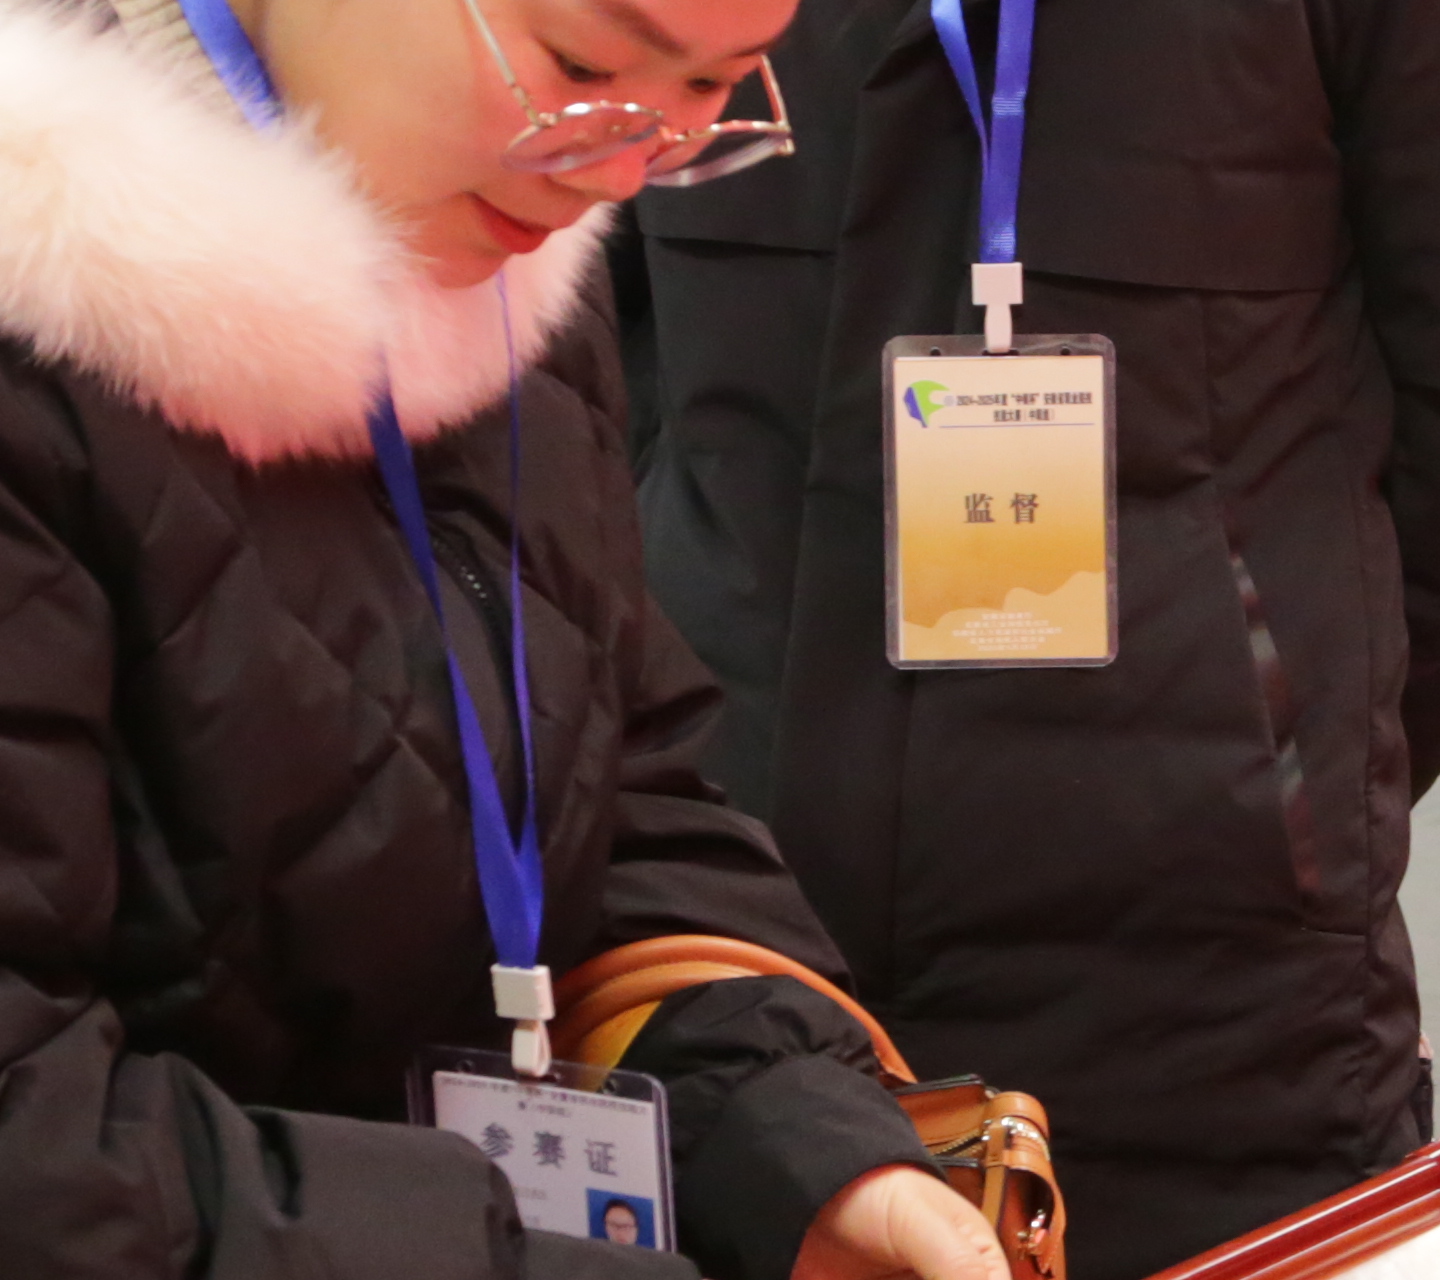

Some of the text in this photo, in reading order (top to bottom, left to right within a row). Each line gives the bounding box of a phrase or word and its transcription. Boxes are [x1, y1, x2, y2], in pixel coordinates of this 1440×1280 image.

[963, 492, 1040, 525] 监督
[479, 1121, 620, 1179] 参赛证
